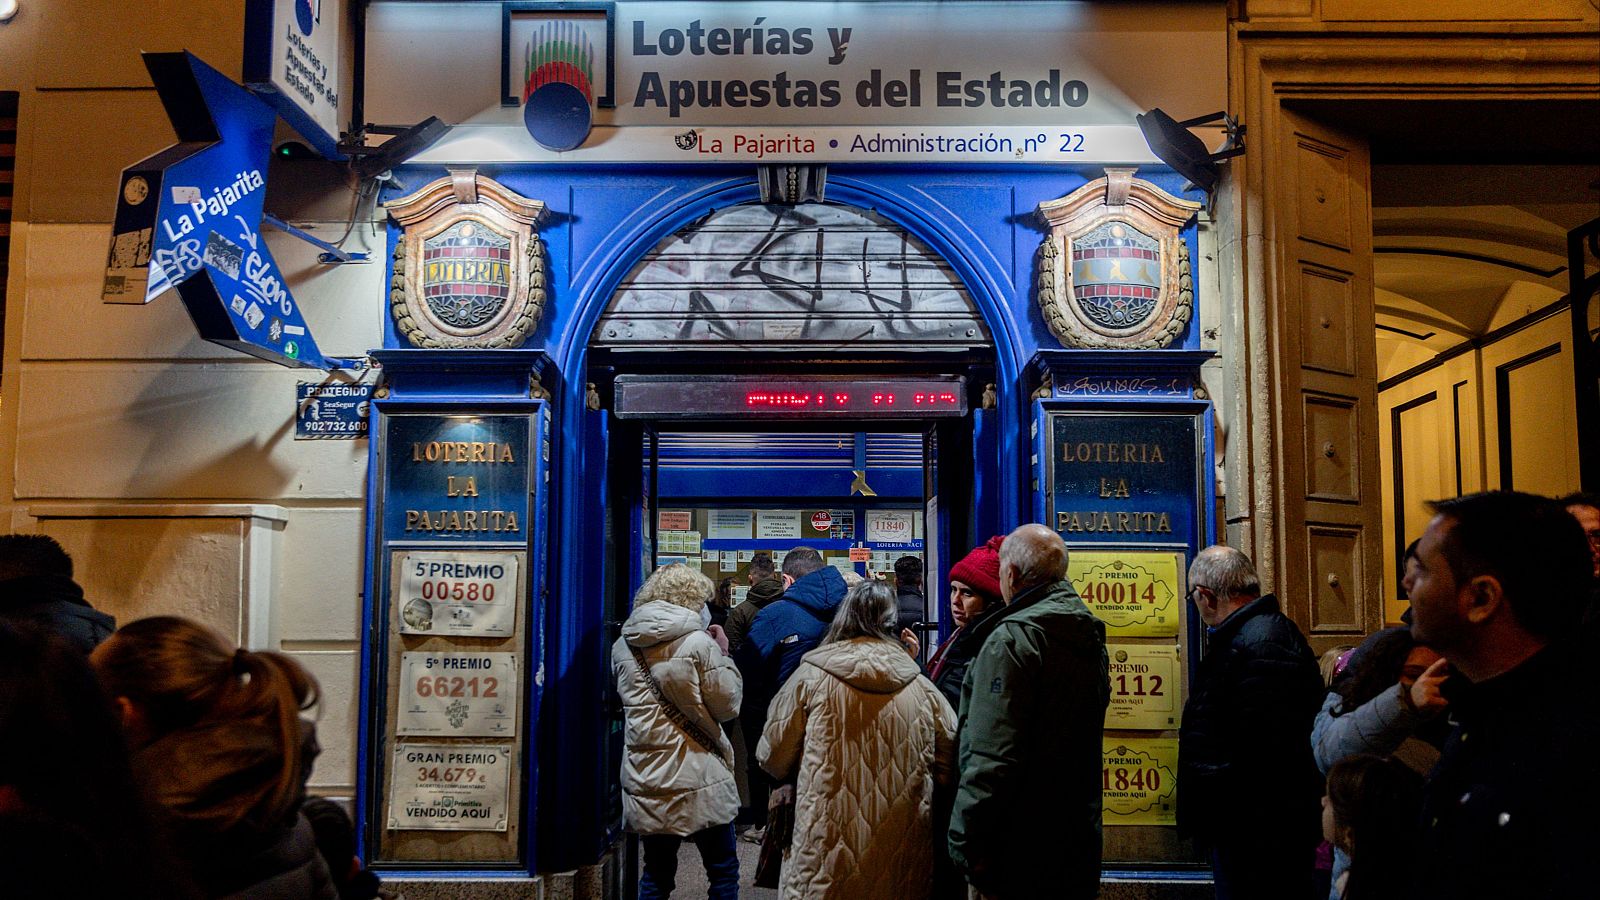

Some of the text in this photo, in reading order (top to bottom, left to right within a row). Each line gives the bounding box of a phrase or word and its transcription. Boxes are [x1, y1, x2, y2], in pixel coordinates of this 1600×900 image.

[632, 16, 853, 65] Loterías y
[286, 46, 338, 109] Apuestas del
[321, 64, 328, 81] y
[285, 64, 315, 105] Estado
[633, 69, 1089, 118] Apuestas del Estado
[698, 135, 723, 154] La
[734, 134, 816, 159] Pajarita
[849, 133, 1013, 154] Administración
[1059, 134, 1085, 153] 22
[162, 168, 264, 243] La Pajarita
[426, 262, 505, 284] LOTERIA
[306, 387, 368, 397] PROTEGIDO
[323, 401, 356, 409] SeaSegur
[305, 421, 368, 431] 902 732 600
[412, 441, 515, 463] LOTERIA
[1063, 442, 1165, 463] LOTERIA
[447, 475, 479, 497] LA
[1099, 477, 1130, 498] LA
[405, 510, 519, 532] PAJARITA
[876, 521, 904, 530] 11840
[1057, 511, 1171, 533] PAJARITA
[430, 563, 504, 580] PREMIO
[422, 580, 495, 602] 00580
[1080, 582, 1156, 604] 40014
[443, 658, 492, 669] PREMIO
[1109, 663, 1149, 674] PREMIO
[416, 676, 498, 698] 66212
[407, 752, 496, 765] GRAN PREMIO
[1108, 757, 1142, 765] PREMIO
[417, 767, 476, 783] 34.679
[1103, 767, 1160, 791] 1840
[406, 806, 491, 819] VENDIDO AQUÍ
